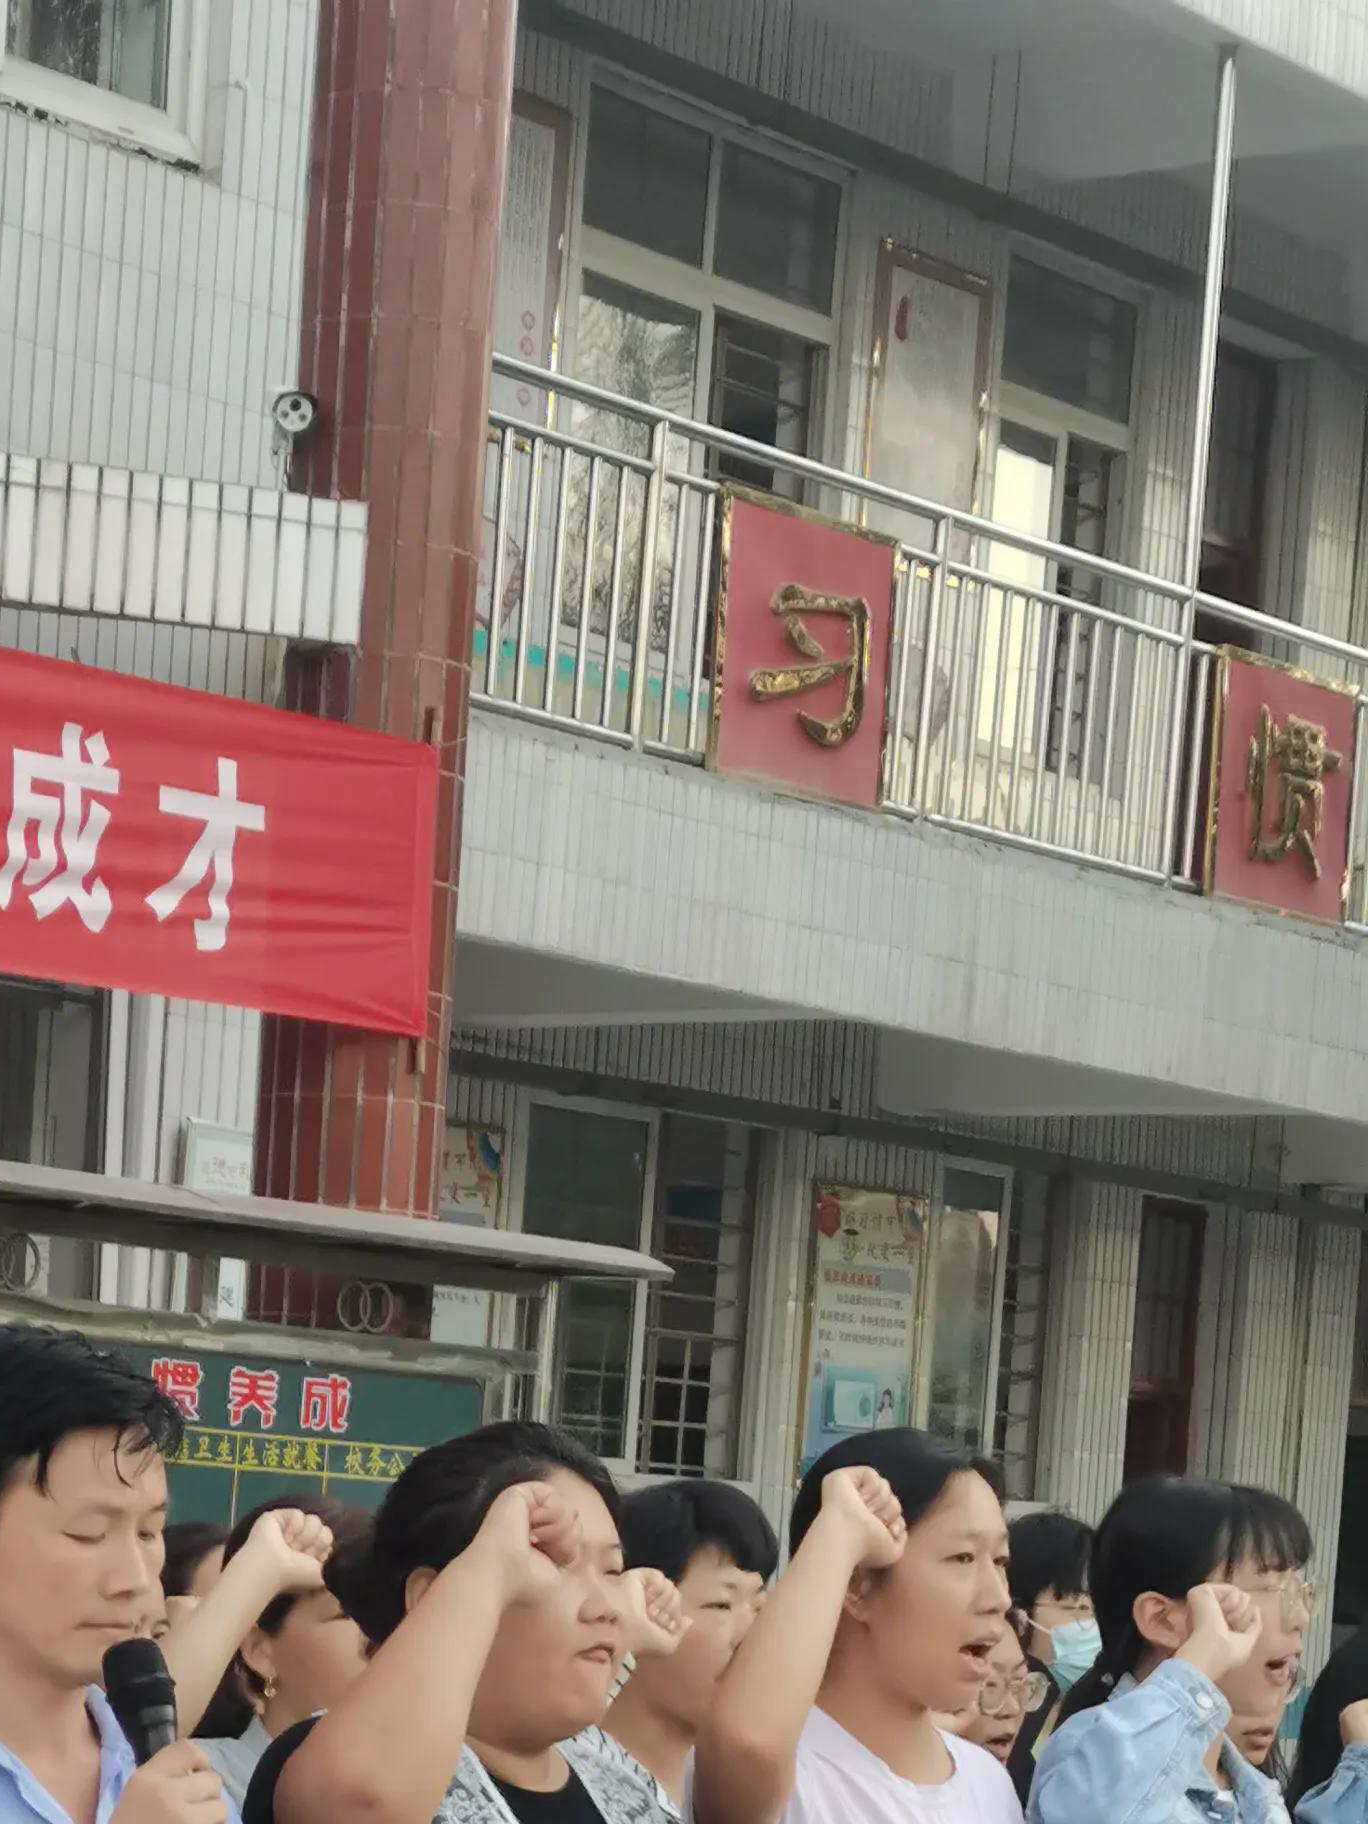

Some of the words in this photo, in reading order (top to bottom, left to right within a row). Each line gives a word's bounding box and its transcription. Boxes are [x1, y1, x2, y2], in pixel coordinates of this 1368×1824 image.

[749, 582, 872, 748] 习
[1248, 703, 1343, 880] 惯
[242, 1438, 322, 1472] 生活就餐
[344, 1444, 420, 1477] 校务公
